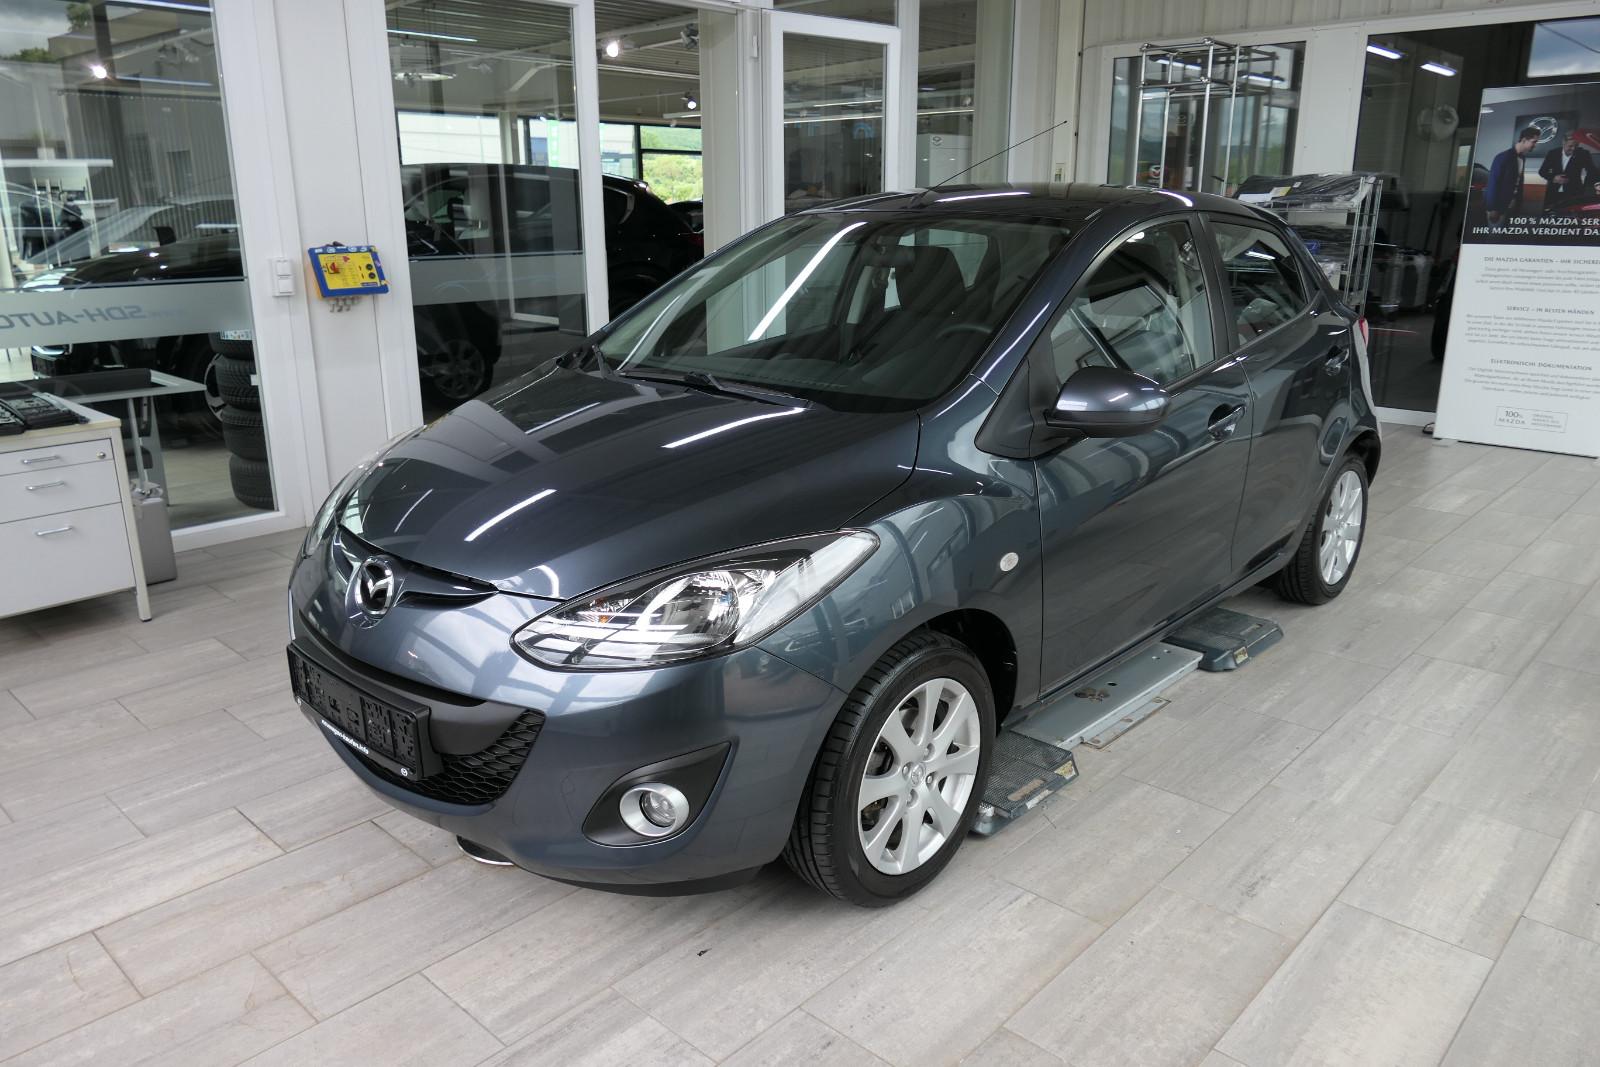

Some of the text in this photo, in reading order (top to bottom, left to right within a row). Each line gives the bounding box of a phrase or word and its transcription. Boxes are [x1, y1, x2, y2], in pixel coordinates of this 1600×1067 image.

[1509, 217, 1527, 225] 100
[1529, 217, 1536, 225] %
[1540, 217, 1578, 226] MAZDA
[1492, 227, 1529, 235] MAZDA
[1532, 227, 1581, 236] VERDIENT
[1584, 228, 1600, 236] DA
[1498, 417, 1525, 425] MAZDA
